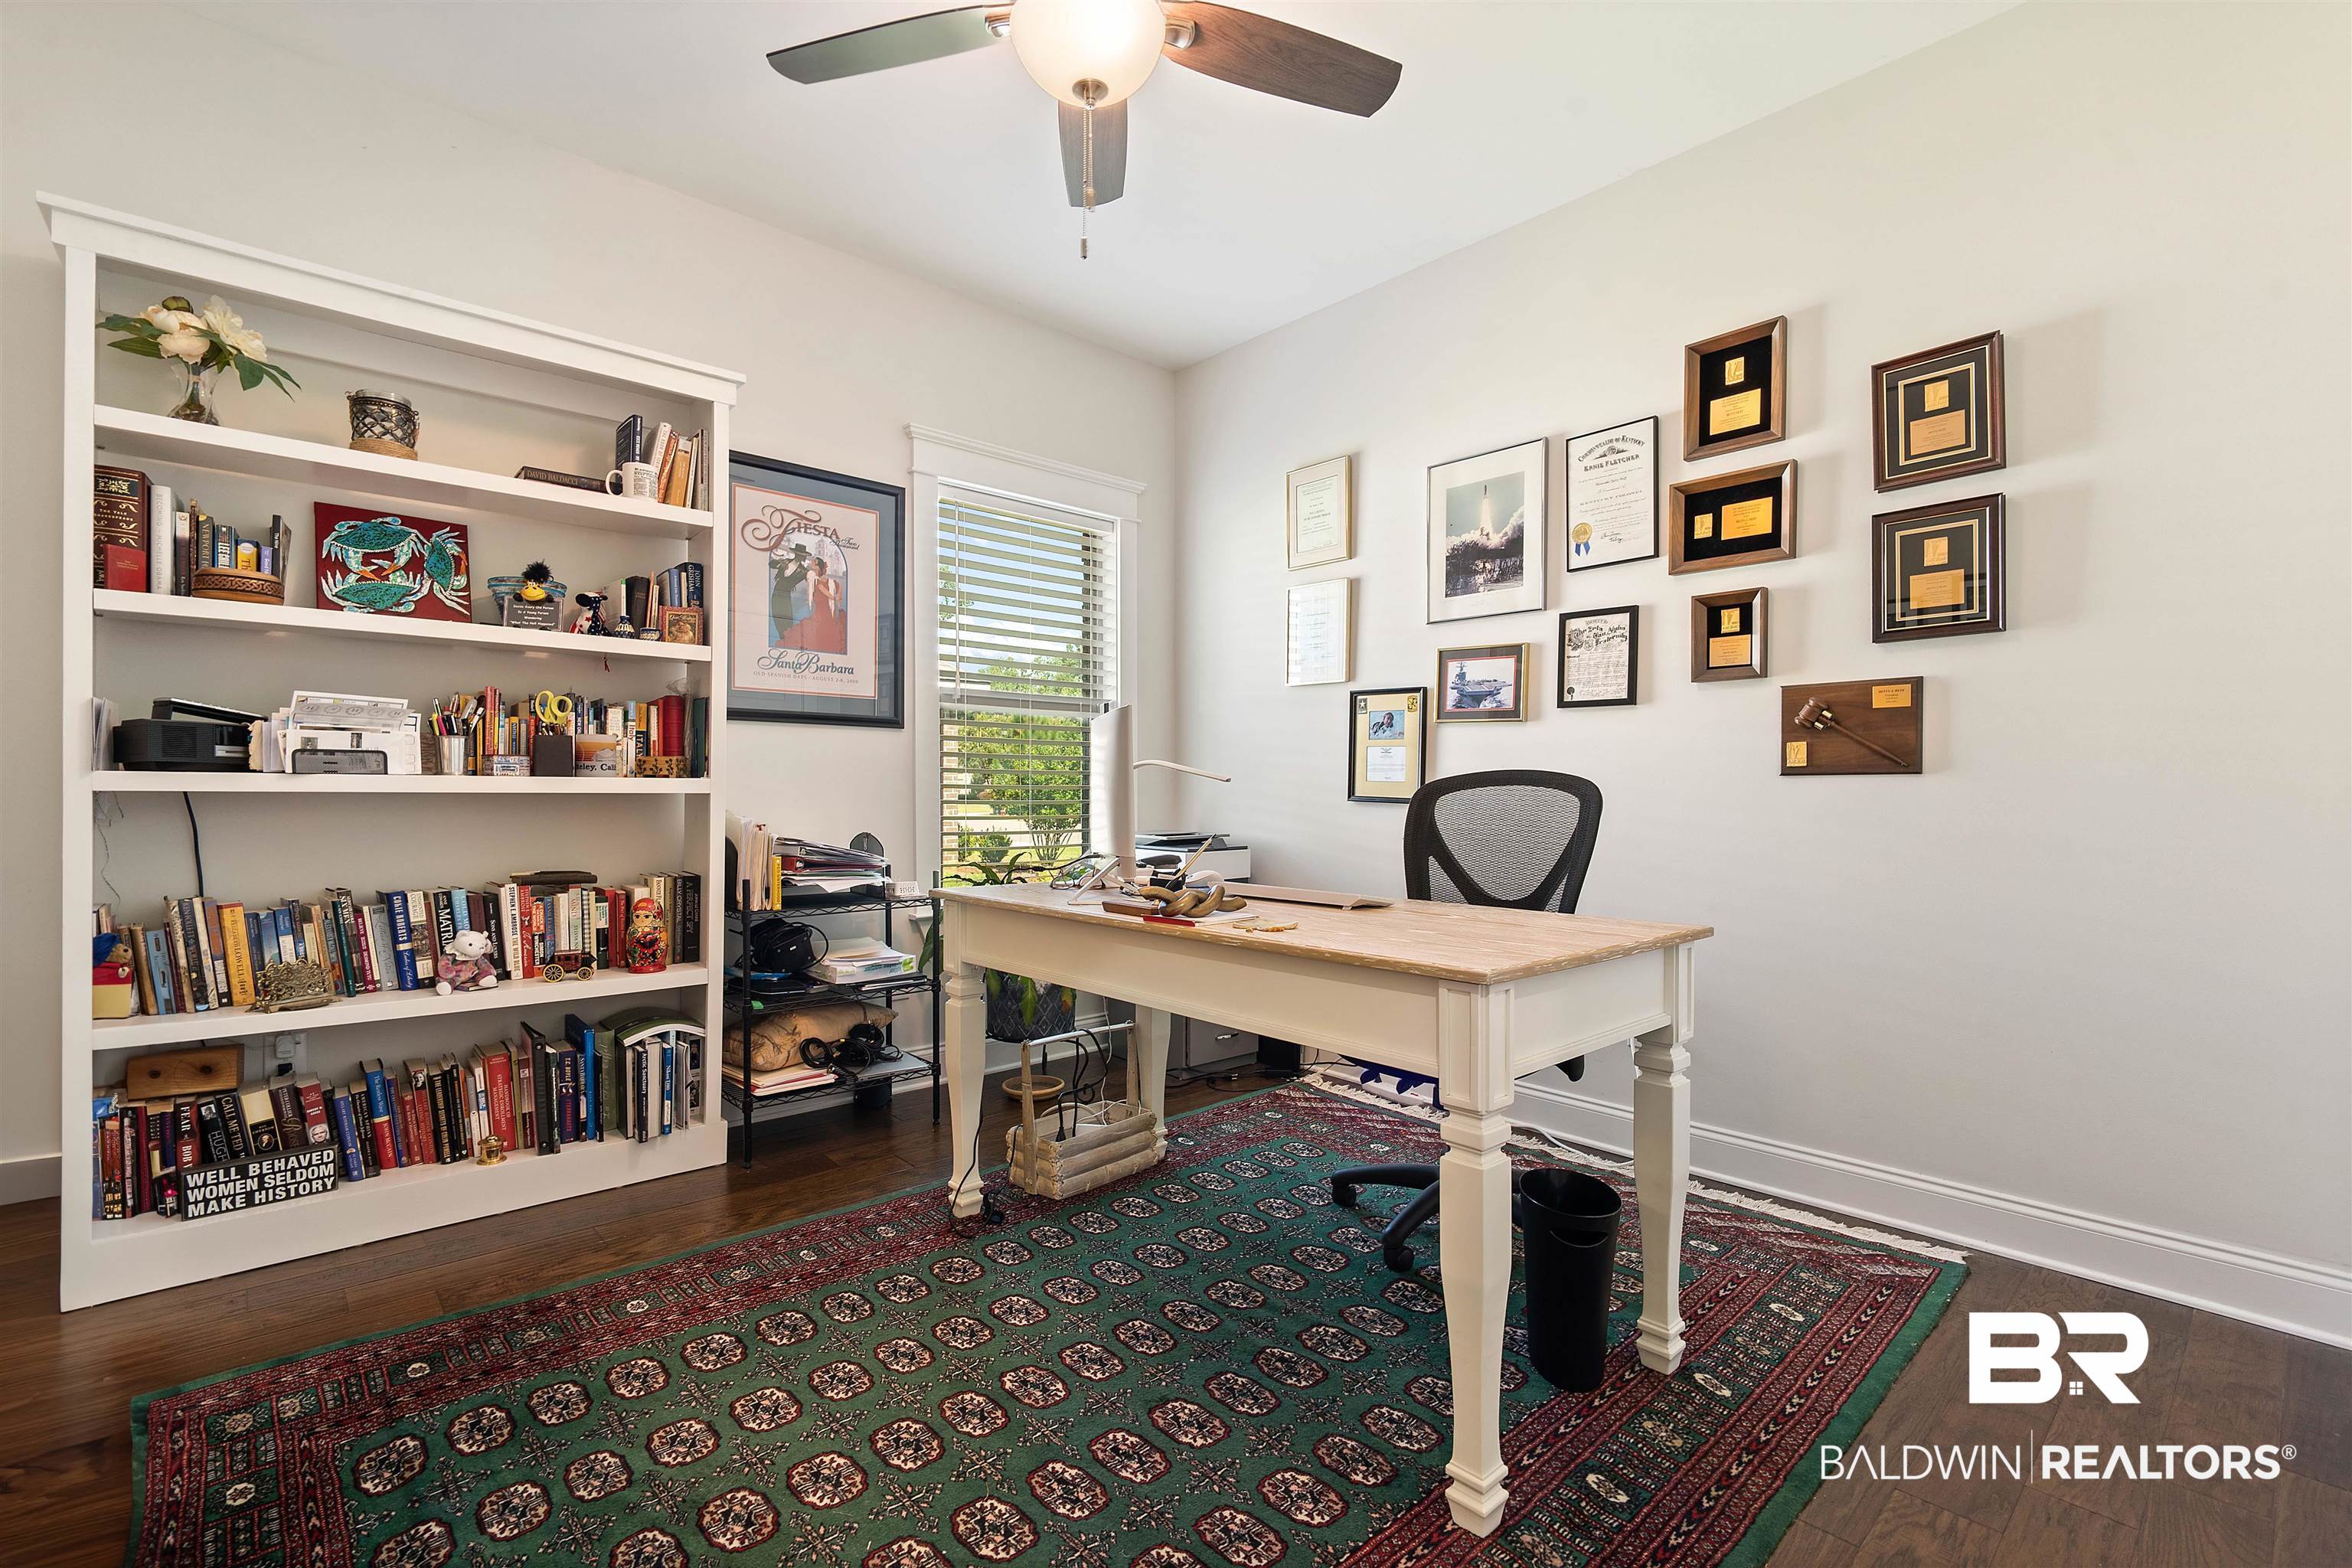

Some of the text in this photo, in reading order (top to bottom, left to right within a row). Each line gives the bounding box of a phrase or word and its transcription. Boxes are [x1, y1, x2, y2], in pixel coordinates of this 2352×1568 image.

[528, 469, 578, 485] DAVID BALDACCI
[1605, 454, 1639, 467] FLETCHER
[757, 648, 854, 675] Santa Barbara
[393, 896, 408, 941] COKIE ROBERTS
[234, 948, 244, 979] LOWELL
[180, 1106, 190, 1131] FEAR
[221, 1097, 243, 1151] CALL ME TED
[435, 1088, 444, 1109] LEADERSHIP
[443, 1144, 451, 1158] POWELL
[182, 1145, 192, 1162] BOB
[186, 1149, 334, 1187] WELL BEHAVED
[186, 1163, 334, 1202] WOMEN SELDOM
[188, 1177, 335, 1217] MAKE HISTORY
